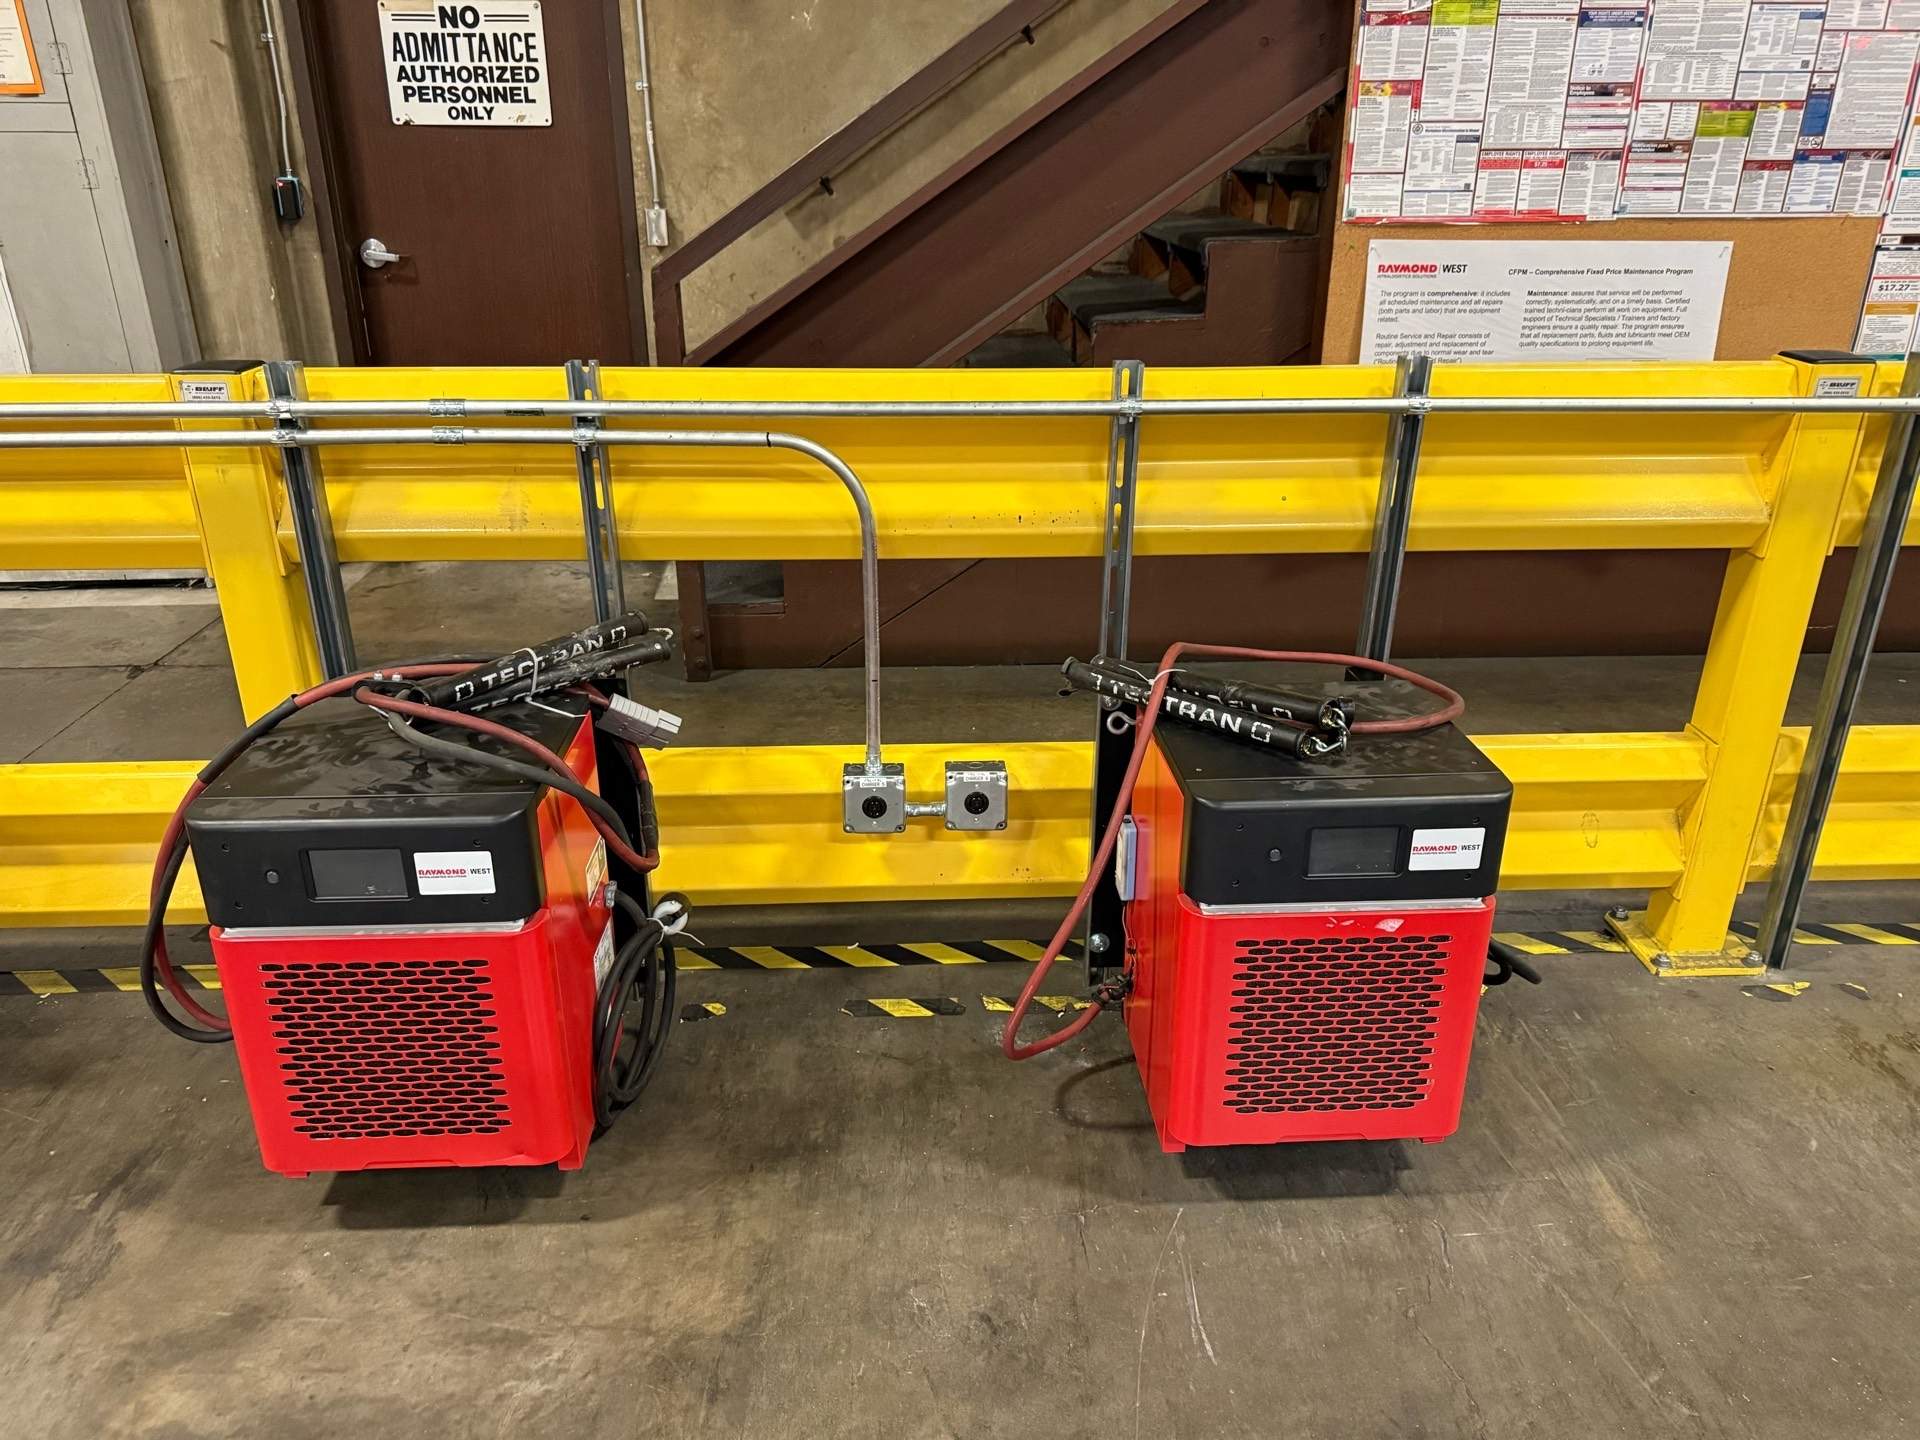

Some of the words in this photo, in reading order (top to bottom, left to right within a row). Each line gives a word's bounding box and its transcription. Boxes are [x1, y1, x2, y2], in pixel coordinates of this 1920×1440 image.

[438, 6, 480, 29] NO
[393, 32, 539, 62] ADMITTANCE
[397, 65, 540, 83] AUTHORIZED
[403, 86, 536, 104] PERSONNEL
[448, 106, 495, 120] ONLY
[1378, 264, 1438, 273] RAYMOND
[1442, 264, 1468, 273] WEST
[1508, 268, 1528, 276] CFPM
[1534, 268, 1585, 276] Comprehensive
[1586, 268, 1605, 276] Fixed
[1605, 268, 1622, 276] Price
[1624, 268, 1664, 276] Maintenance
[1665, 268, 1694, 276] Program
[1381, 290, 1392, 298] The
[1392, 290, 1419, 298] program
[1420, 290, 1426, 298] is
[1486, 290, 1511, 298] includes
[1570, 289, 1595, 297] assures
[1595, 289, 1608, 297] that
[1608, 289, 1630, 297] service
[1631, 289, 1641, 297] will
[1642, 289, 1650, 297] be
[1651, 289, 1683, 297] performed
[1599, 298, 1610, 306] and
[1612, 298, 1620, 306] on
[1621, 298, 1626, 306] a
[1627, 298, 1645, 306] timely
[1665, 298, 1691, 306] Certified
[1378, 307, 1394, 315] (both
[1394, 307, 1411, 315] parts
[1411, 307, 1424, 315] and
[1424, 307, 1443, 315] labor)
[1443, 307, 1456, 315] that
[1456, 307, 1468, 315] are
[1468, 307, 1501, 315] equipment
[1524, 306, 1545, 314] trained
[1582, 306, 1607, 314] perform
[1608, 306, 1616, 314] all
[1616, 306, 1630, 314] work
[1632, 306, 1640, 314] on
[1675, 306, 1688, 314] Full
[1521, 323, 1551, 331] engineers
[1552, 323, 1573, 331] ensure
[1574, 323, 1579, 331] a
[1579, 323, 1600, 331] quality
[1621, 323, 1633, 331] The
[1633, 323, 1659, 331] program
[1660, 323, 1685, 331] ensures
[1376, 332, 1398, 340] Routine
[1399, 332, 1422, 340] Service
[1423, 332, 1436, 340] and
[1436, 332, 1457, 340] Repair
[1457, 332, 1483, 340] consists
[1483, 332, 1491, 340] of
[1520, 331, 1532, 339] that
[1532, 331, 1541, 339] all
[1541, 331, 1579, 339] replacement
[1597, 331, 1613, 339] fluids
[1614, 331, 1626, 339] and
[1627, 331, 1656, 339] lubricants
[1657, 331, 1673, 339] meet
[1673, 331, 1690, 339] OEM
[1518, 340, 1539, 348] quality
[1540, 340, 1580, 348] specifications
[1581, 340, 1587, 348] to
[1587, 340, 1611, 348] prolong
[1611, 340, 1643, 348] equipment
[1410, 349, 1423, 357] due
[1423, 349, 1430, 357] to
[1430, 349, 1452, 357] normal
[1452, 349, 1469, 357] wear
[1469, 349, 1481, 357] and
[1482, 349, 1494, 357] tear
[418, 868, 467, 876] RAYMOND
[469, 867, 491, 875] WEST
